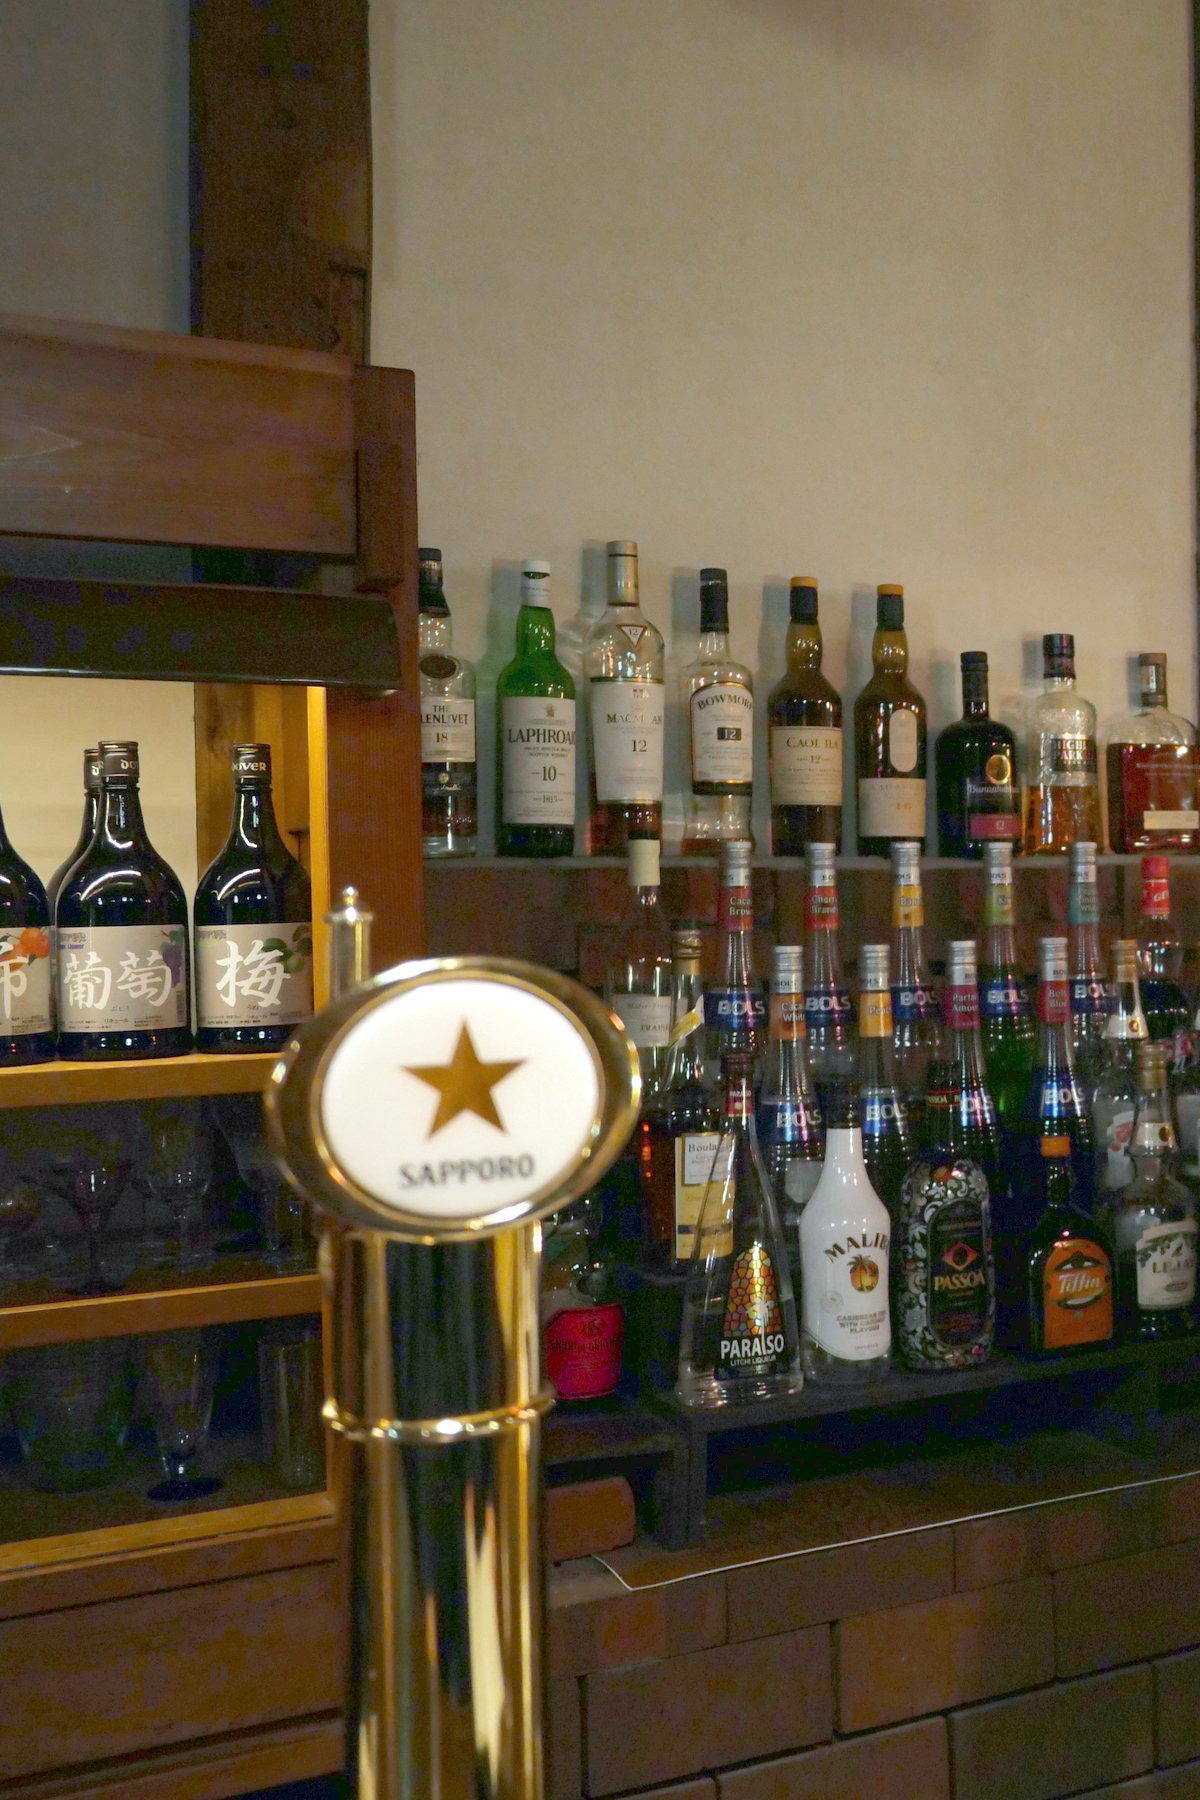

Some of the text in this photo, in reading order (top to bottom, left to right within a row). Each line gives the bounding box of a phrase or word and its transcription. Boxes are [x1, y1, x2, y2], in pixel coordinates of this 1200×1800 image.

[628, 628, 639, 636] 12
[697, 694, 753, 712] BOWMOR
[607, 712, 662, 725] MACALAN
[435, 732, 449, 744] 18
[724, 729, 737, 739] 12
[632, 739, 647, 752] 12
[542, 766, 557, 781] 10
[64, 950, 172, 1010] 葡萄
[215, 939, 291, 1008] 梅
[717, 1000, 766, 1015] BOLS
[806, 996, 851, 1011] BOLS
[776, 1109, 823, 1128] BOLS
[398, 1154, 535, 1190] SAPPORO
[1058, 1272, 1101, 1294] Tiffin
[720, 1334, 785, 1360] PARAISO
